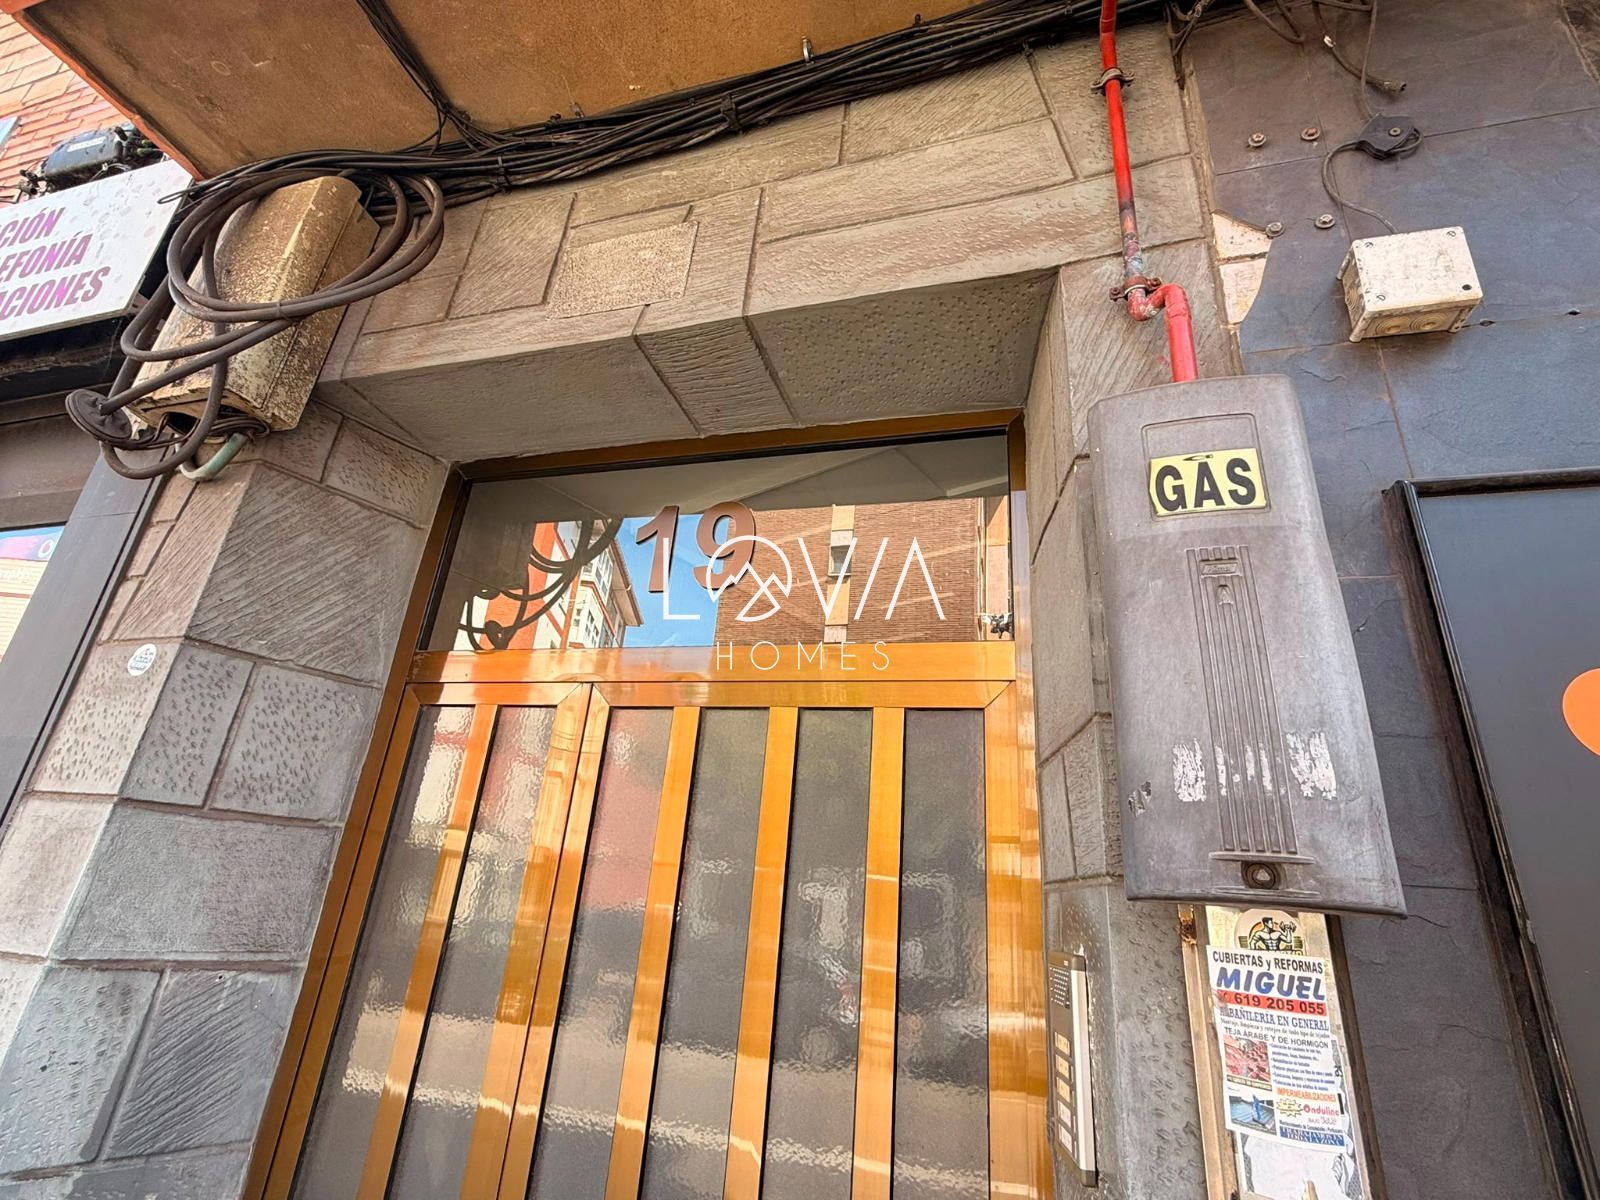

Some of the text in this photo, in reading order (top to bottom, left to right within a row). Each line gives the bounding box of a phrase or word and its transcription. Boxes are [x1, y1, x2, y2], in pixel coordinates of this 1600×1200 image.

[1155, 457, 1257, 512] GAS
[635, 501, 756, 593] 19
[1212, 950, 1323, 974] CUBIERTAS y REFORMAS
[1216, 966, 1325, 1001] MIGUEL
[1234, 993, 1324, 1015] 619 205 055
[1276, 1015, 1289, 1027] EN
[1291, 1017, 1329, 1031] GENERAL
[1224, 1026, 1241, 1036] TEJA
[1270, 1034, 1276, 1042] Y
[1278, 1036, 1289, 1044] DE
[1303, 1103, 1340, 1116] Onduline
